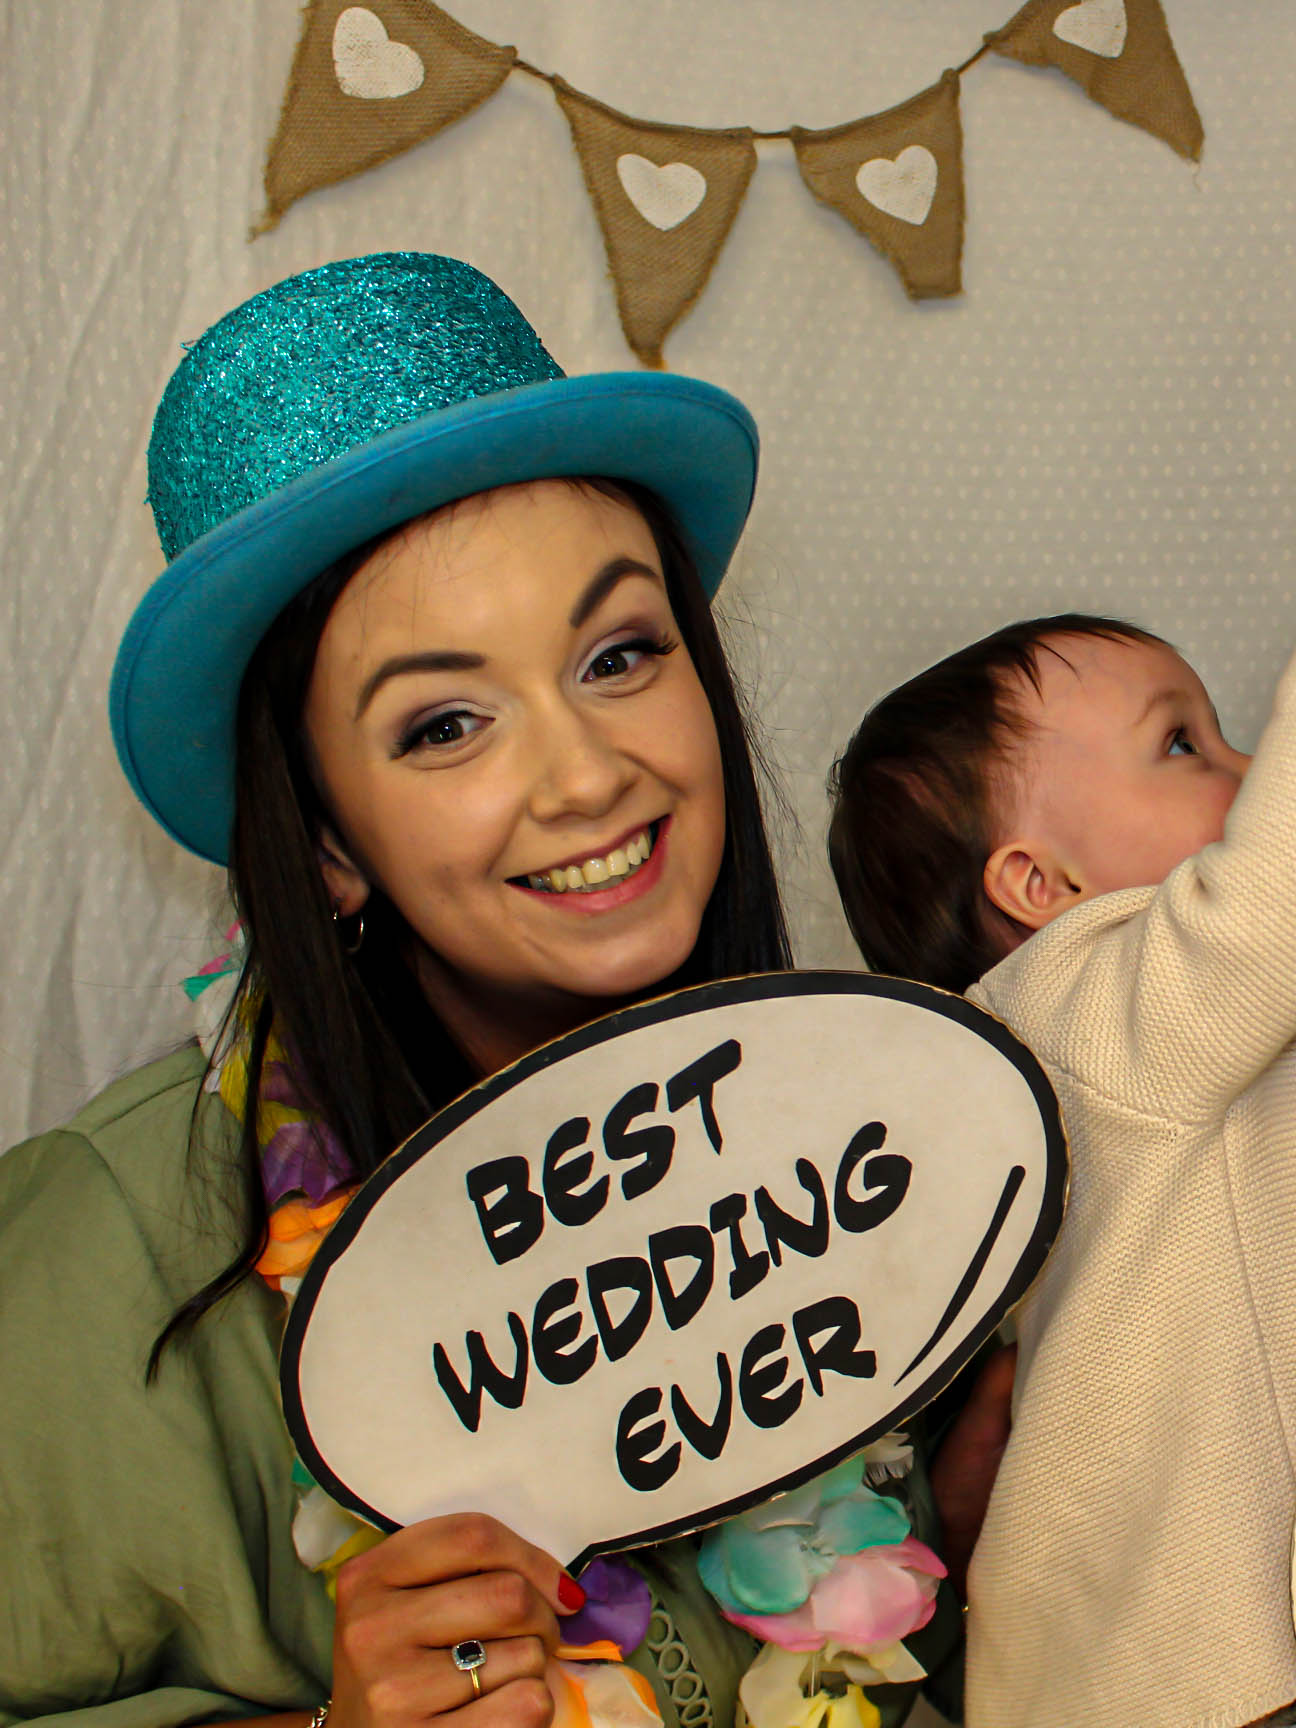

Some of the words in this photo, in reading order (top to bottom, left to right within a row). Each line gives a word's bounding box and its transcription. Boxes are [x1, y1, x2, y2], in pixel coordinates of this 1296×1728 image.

[466, 1039, 741, 1265] BEST
[433, 1122, 912, 1432] WEDDING
[616, 1297, 876, 1491] EVER
